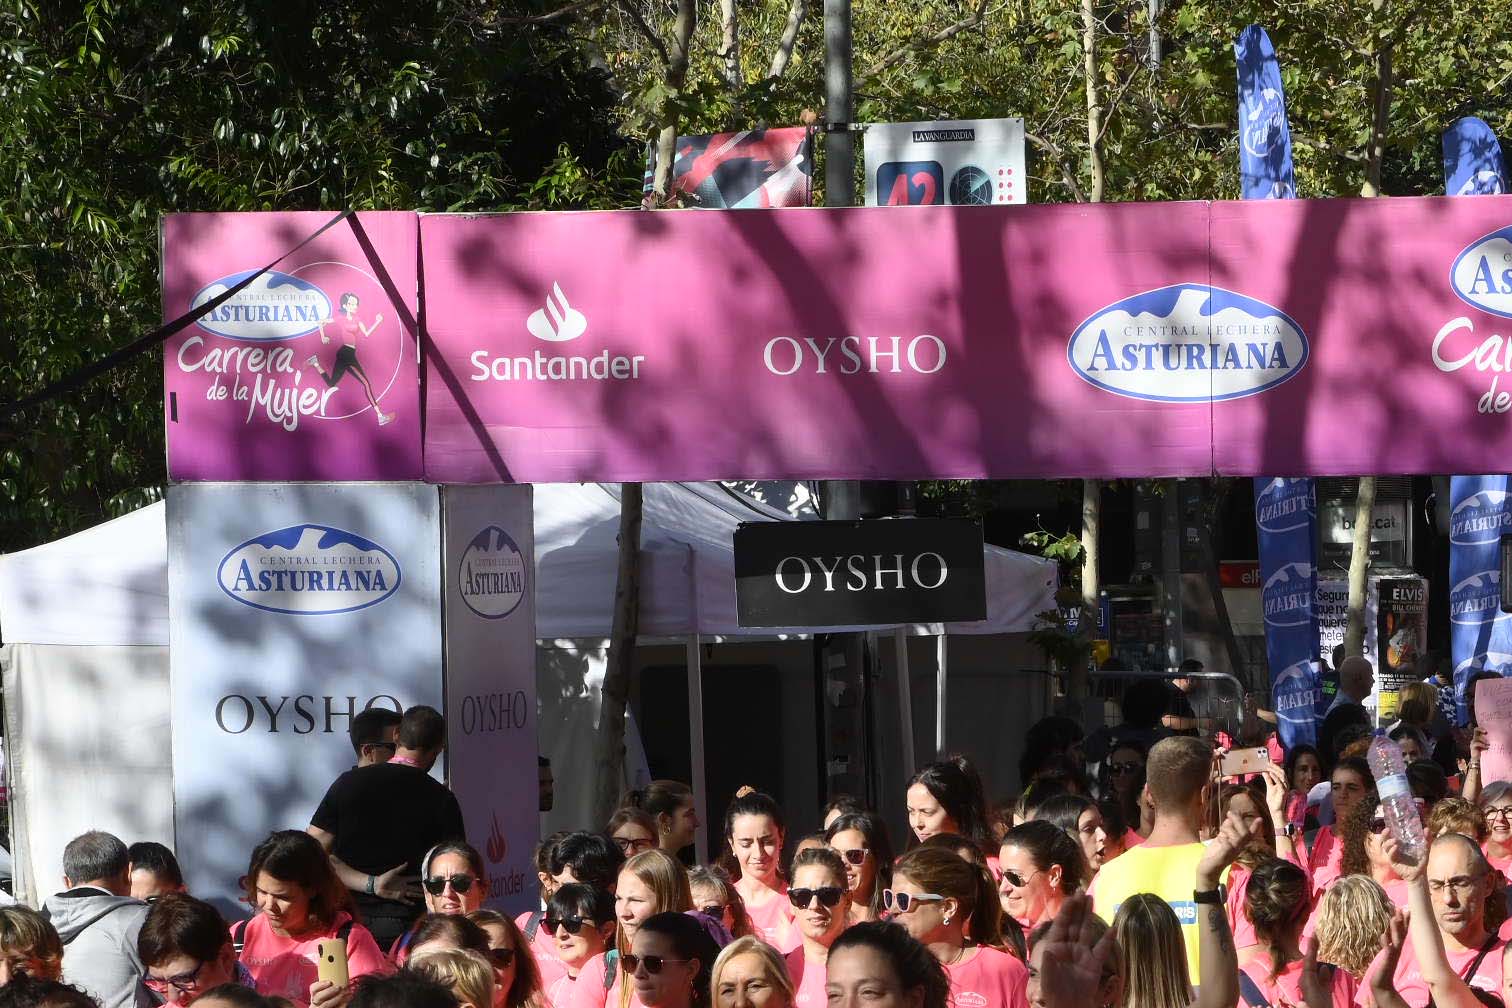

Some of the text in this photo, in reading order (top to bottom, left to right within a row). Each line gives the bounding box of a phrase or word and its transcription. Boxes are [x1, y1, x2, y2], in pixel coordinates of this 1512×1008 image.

[200, 296, 320, 323] ASTURIANA
[1124, 323, 1282, 337] CENTRAL LECHERA
[177, 336, 295, 374] Carrera
[470, 350, 645, 381] Santander
[764, 334, 948, 376] OYSHO
[1086, 329, 1290, 372] ASTURIANA
[206, 369, 339, 432] de la Mujer
[1477, 376, 1512, 414] de
[231, 558, 388, 592] ASTURIANA
[260, 554, 383, 566] CENTRAL LECHERA
[775, 551, 949, 594] OYSHO
[464, 563, 522, 597] ASTURIANA
[1317, 588, 1349, 603] Segur
[1392, 587, 1425, 601] ELVIS
[1319, 618, 1349, 632] quiere
[215, 693, 403, 735] OYSH
[460, 690, 527, 737] OYSHO
